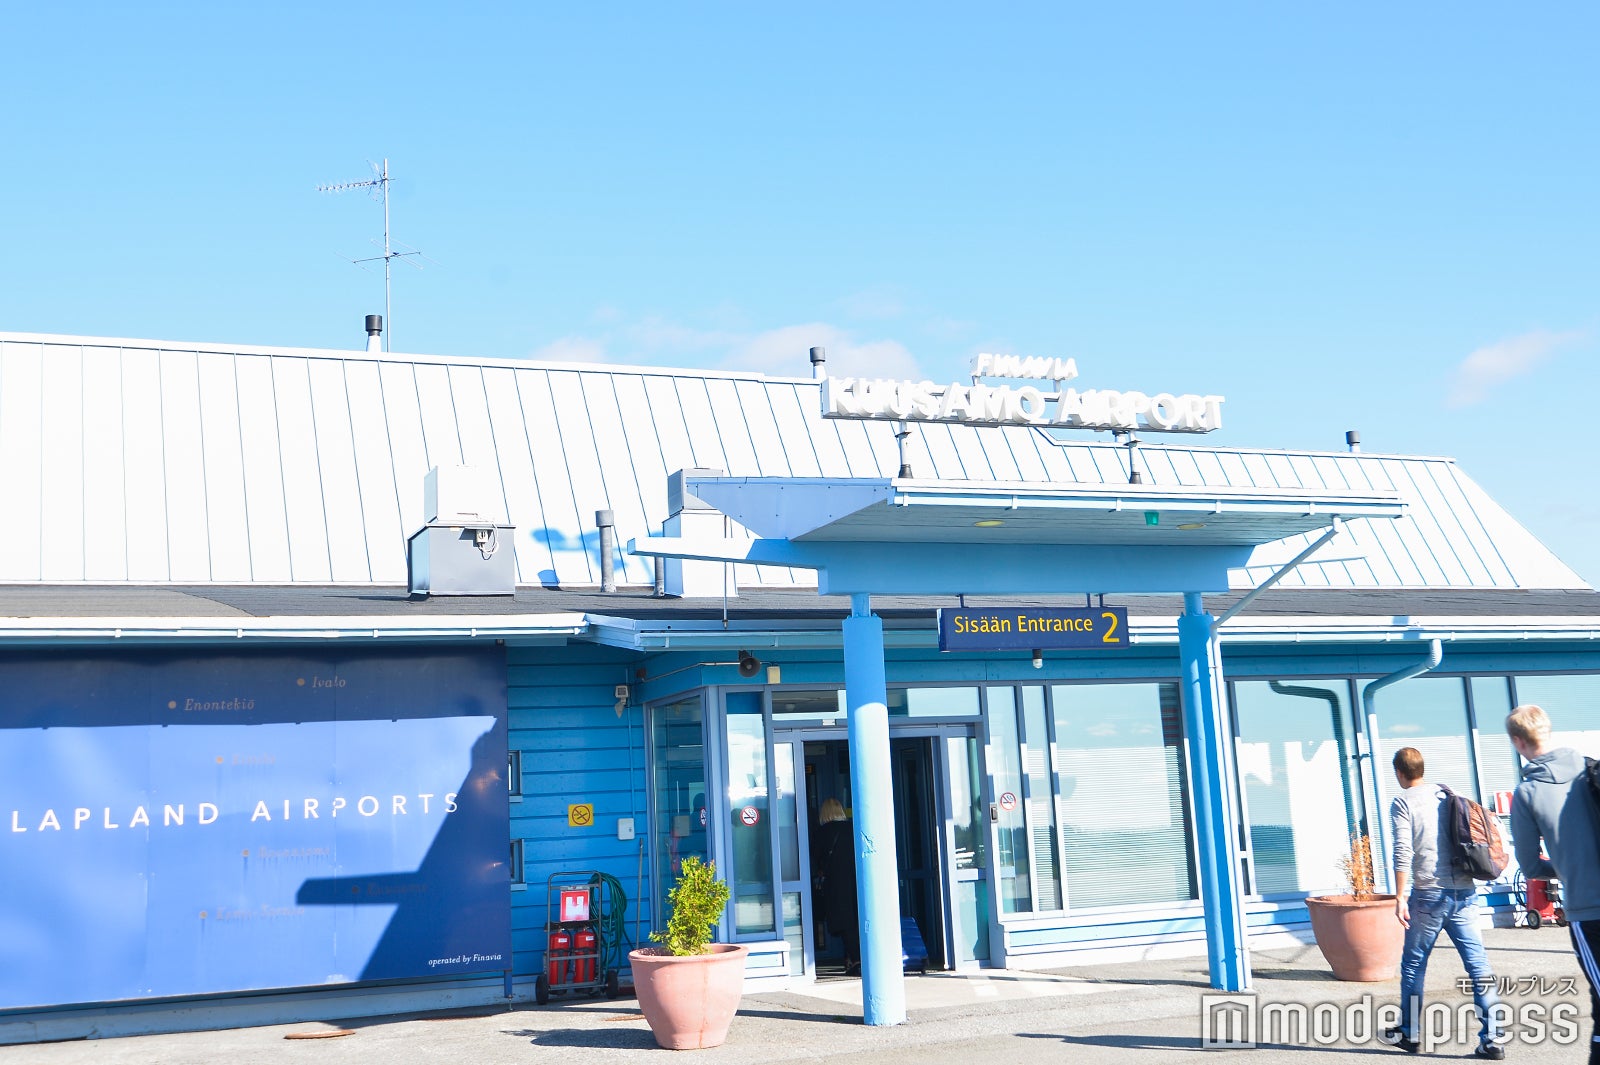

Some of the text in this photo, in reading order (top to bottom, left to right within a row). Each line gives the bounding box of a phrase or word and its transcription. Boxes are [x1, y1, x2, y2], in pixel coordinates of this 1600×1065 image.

[974, 353, 1079, 379] FINAVIA
[823, 375, 1226, 432] KUUSAMO AIRPORT
[954, 612, 1120, 643] Sisään Entrance 2
[312, 676, 346, 688] Ivalo
[11, 792, 459, 833] LAPLAND AIRPORTS
[428, 953, 502, 968] operated by Finavia
